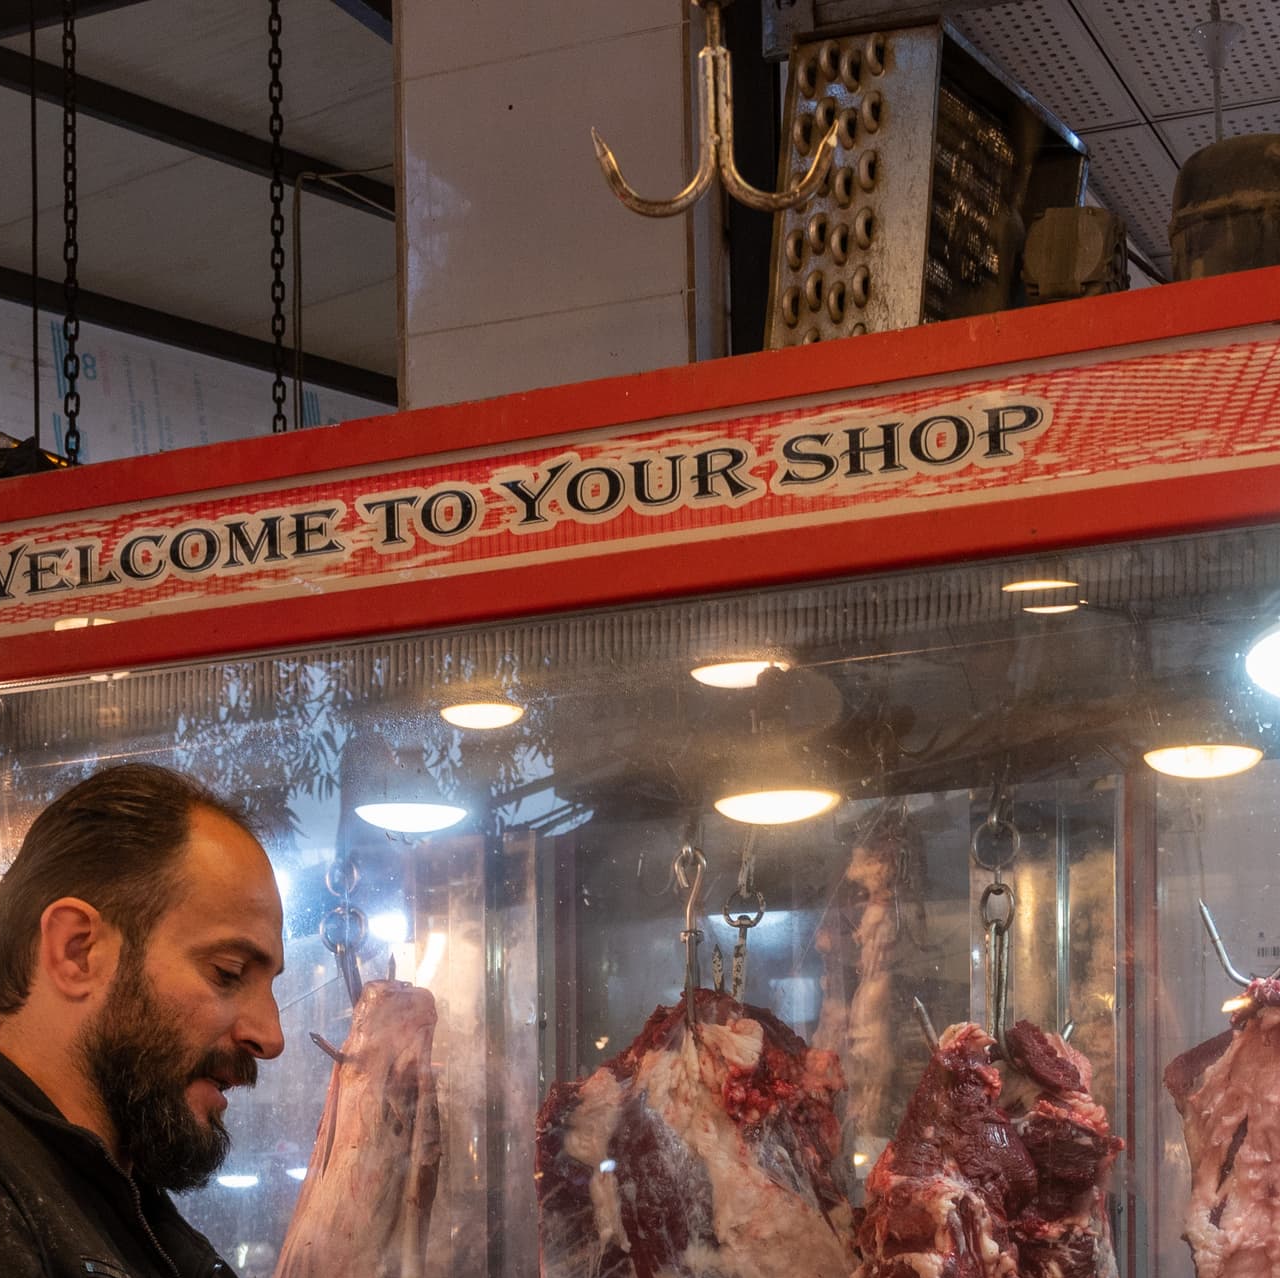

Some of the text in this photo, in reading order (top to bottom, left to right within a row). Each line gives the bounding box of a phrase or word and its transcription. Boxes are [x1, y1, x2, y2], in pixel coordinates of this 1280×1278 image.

[363, 490, 478, 545] TO
[501, 446, 759, 526] YOUR
[780, 404, 1045, 486] SHOP
